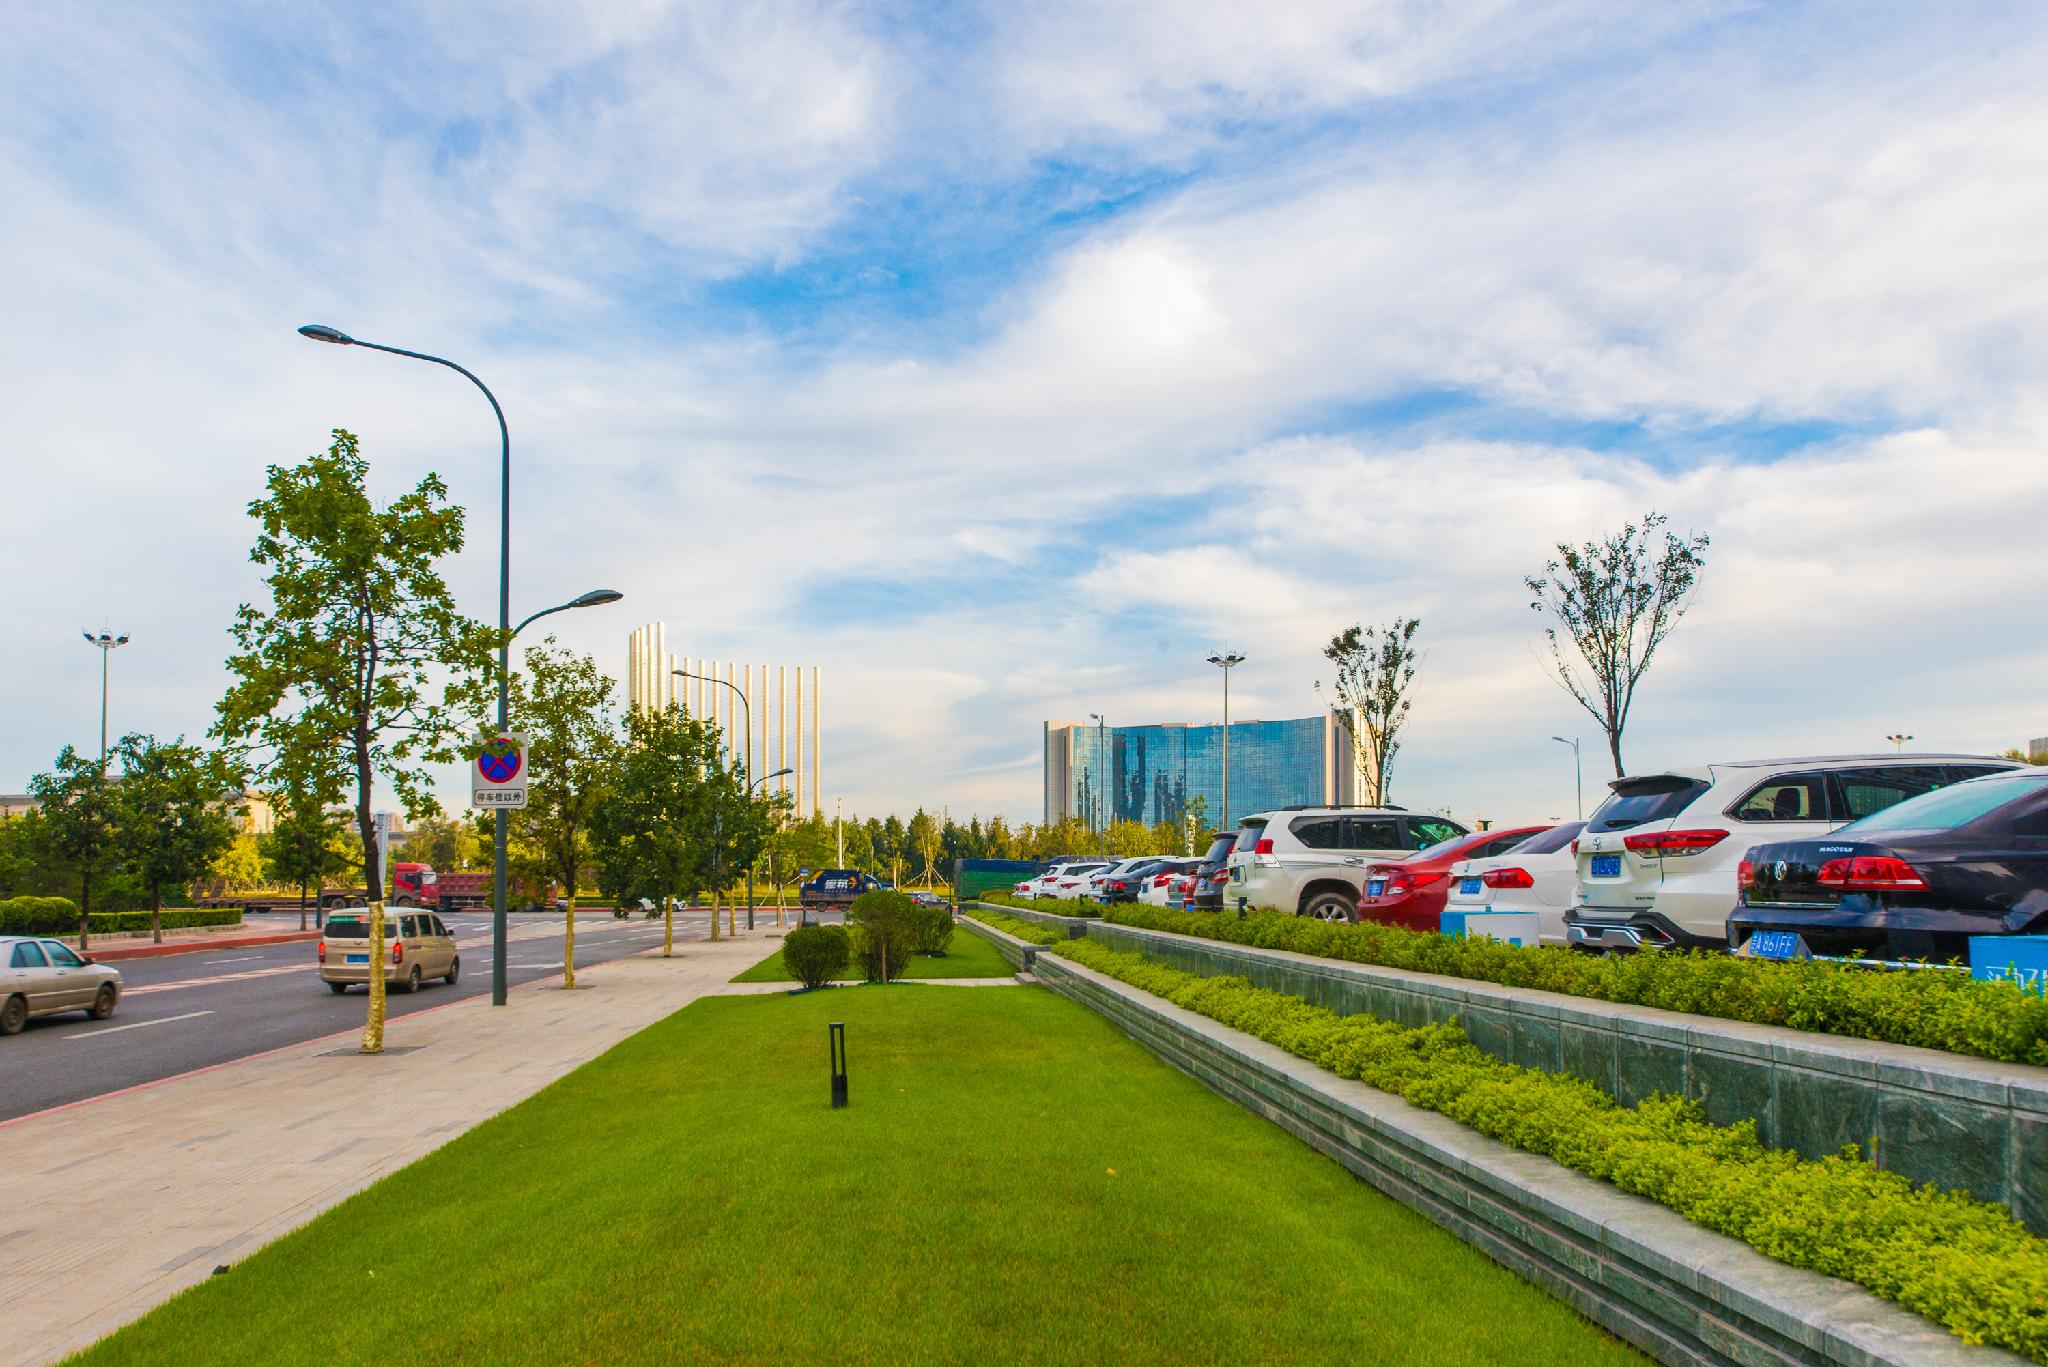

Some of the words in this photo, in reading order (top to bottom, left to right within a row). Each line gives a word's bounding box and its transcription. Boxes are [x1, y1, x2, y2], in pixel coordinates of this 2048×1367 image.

[477, 792, 522, 802] 停车位以外
